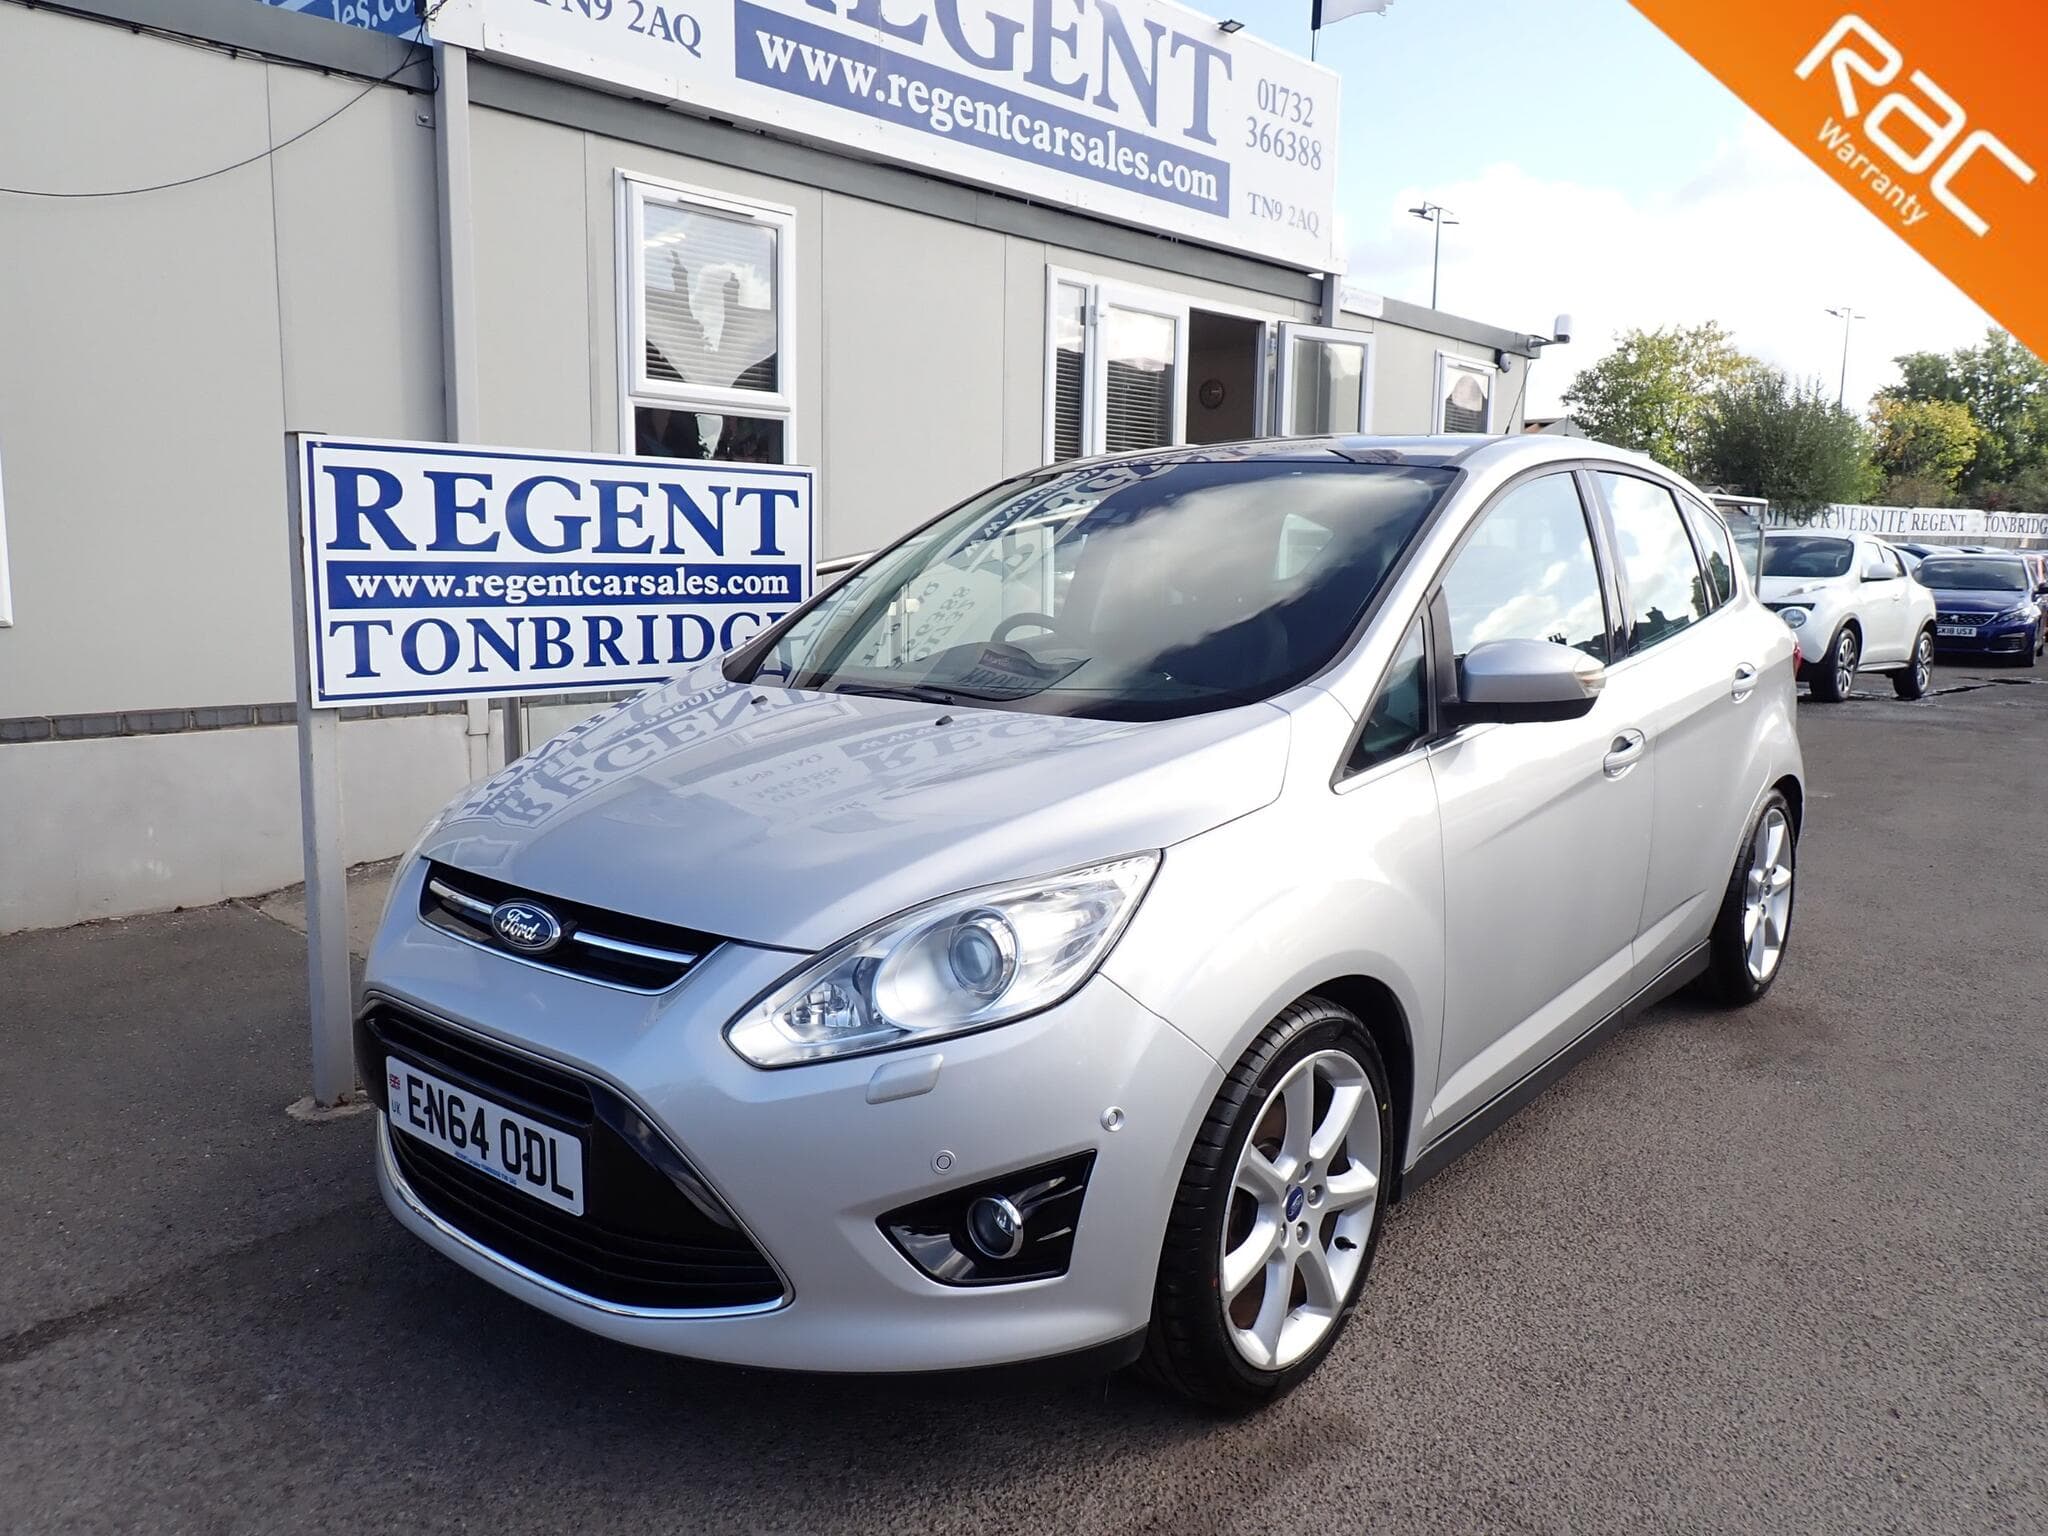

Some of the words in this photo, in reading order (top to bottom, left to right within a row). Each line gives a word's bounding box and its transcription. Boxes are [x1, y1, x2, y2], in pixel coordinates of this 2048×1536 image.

[627, 0, 701, 58] 2AQ
[755, 30, 1218, 201] www.regentcarsales.com
[1257, 78, 1313, 128] 01732
[1245, 116, 1322, 171] 366388
[1247, 191, 1283, 222] TN9
[1287, 205, 1319, 238] 2AQ
[322, 465, 800, 556] REGENT
[1836, 506, 1908, 533] WEBSITE
[1911, 513, 1967, 532] REGENT
[345, 566, 790, 605] www.regentcarsales.com
[329, 612, 789, 679] TONBRIDG
[500, 908, 541, 941] Ford
[406, 1073, 490, 1161] EN64
[500, 1118, 574, 1201] ODL
